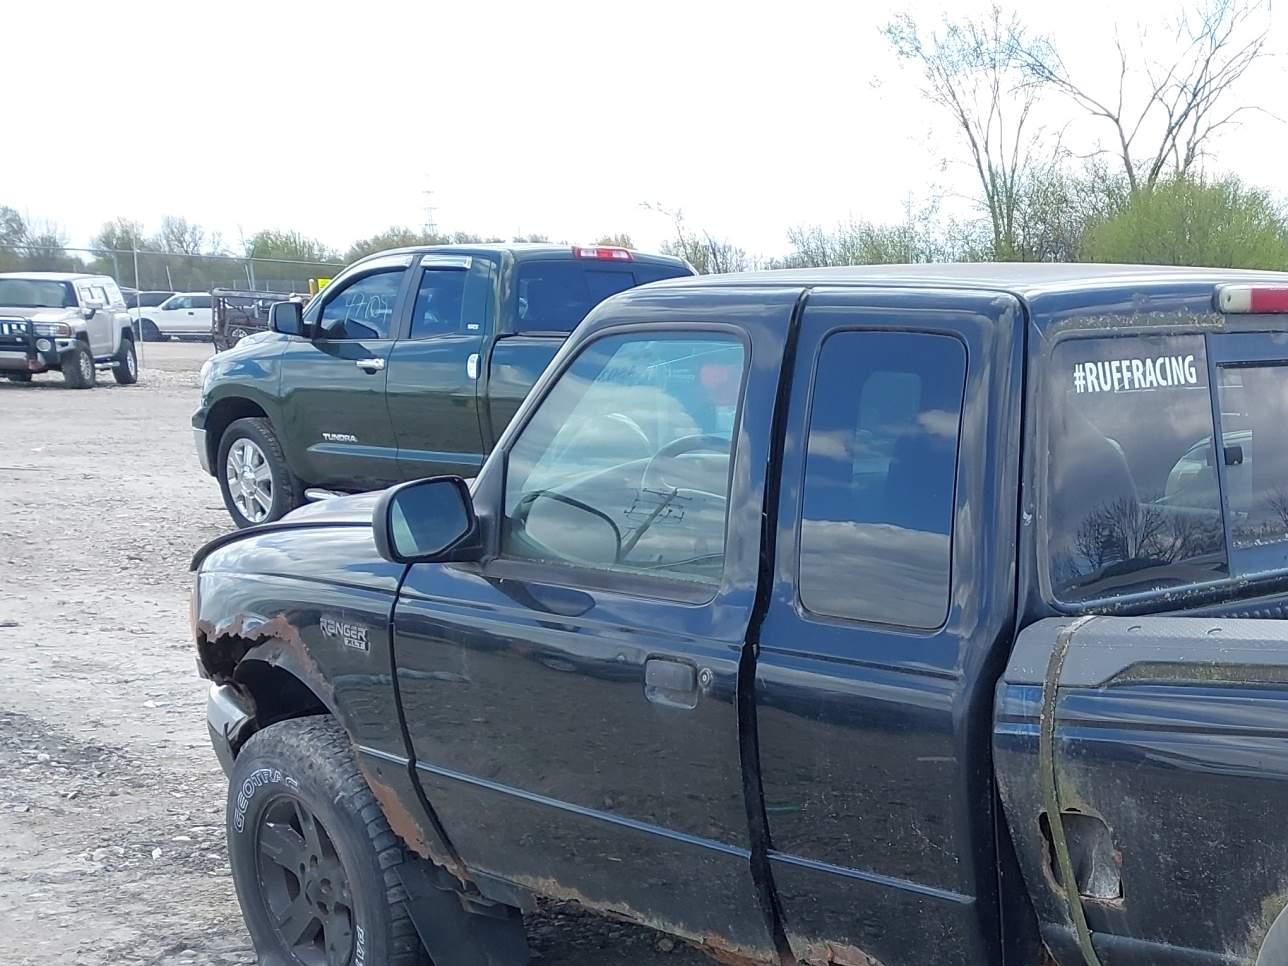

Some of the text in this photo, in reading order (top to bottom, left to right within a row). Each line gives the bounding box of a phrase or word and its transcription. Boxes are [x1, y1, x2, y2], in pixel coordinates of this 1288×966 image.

[1073, 355, 1198, 393] #RUFFRACING
[322, 432, 359, 442] TUNDRA
[234, 768, 299, 833] GEOTRAC
